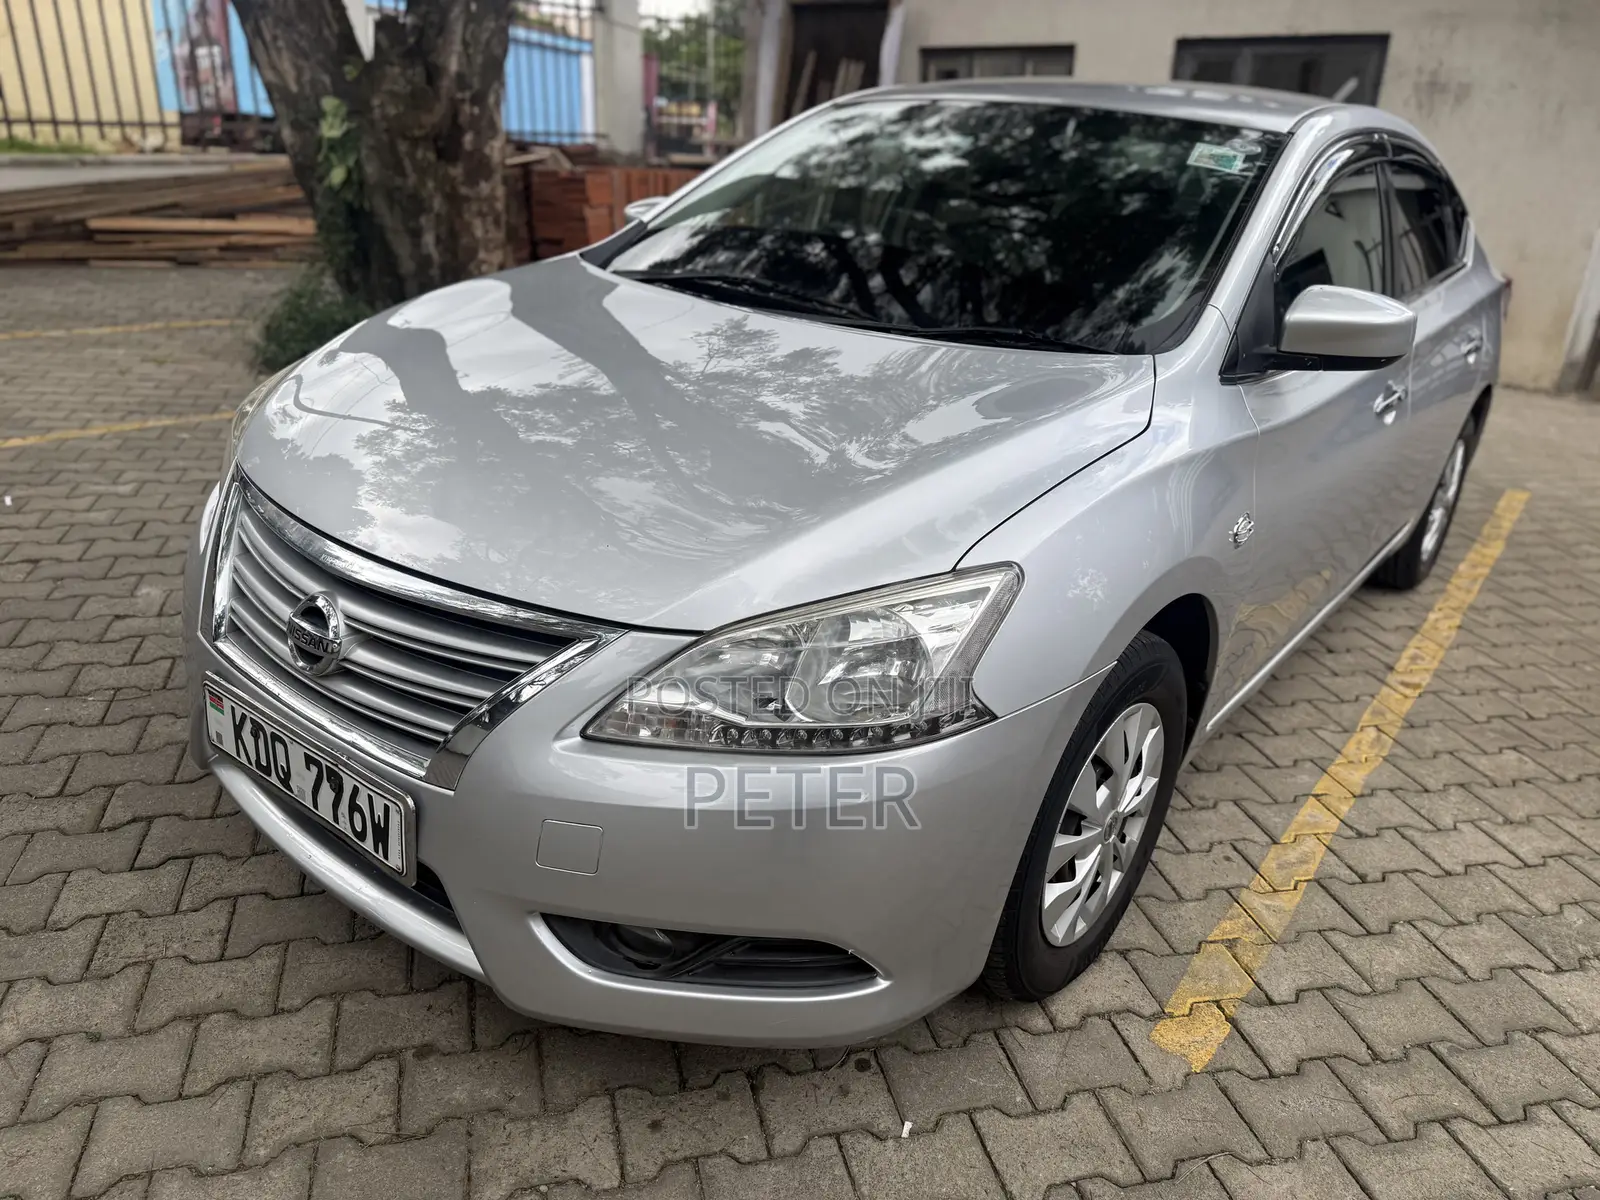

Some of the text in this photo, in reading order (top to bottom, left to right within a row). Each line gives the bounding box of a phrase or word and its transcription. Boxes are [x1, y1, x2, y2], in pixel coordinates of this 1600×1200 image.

[289, 620, 329, 652] NISSAN
[231, 704, 293, 793] KDQ
[304, 755, 390, 861] 776W
